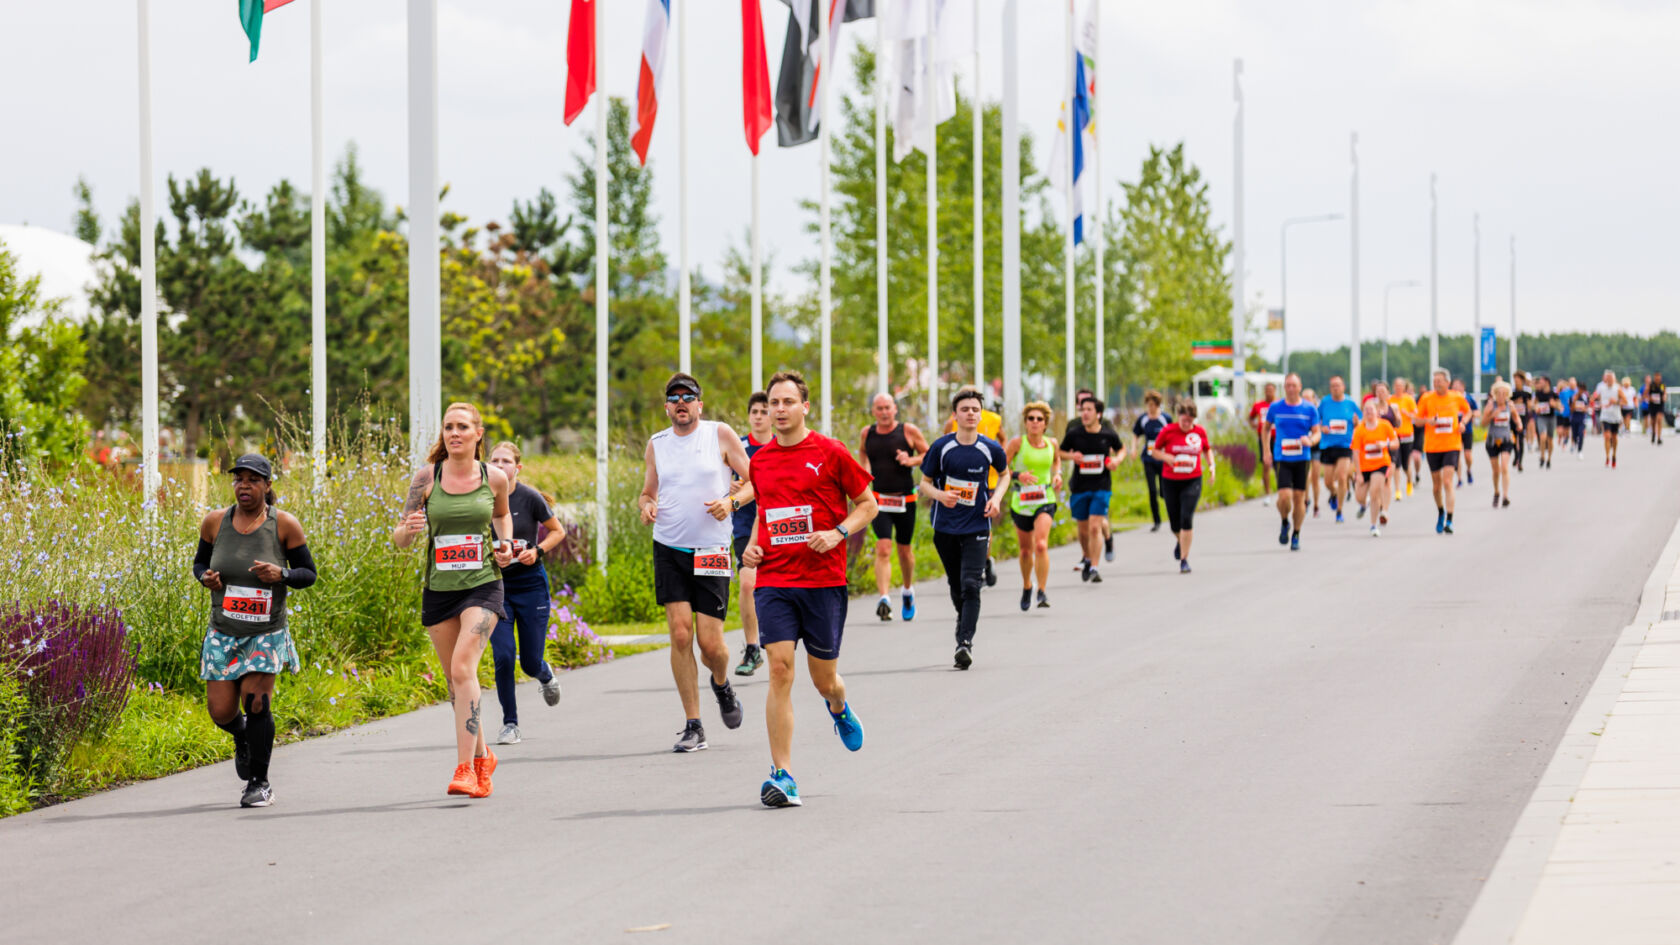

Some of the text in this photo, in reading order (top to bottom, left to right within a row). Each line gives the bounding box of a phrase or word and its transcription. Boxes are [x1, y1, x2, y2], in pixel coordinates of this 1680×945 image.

[771, 520, 808, 535] 3059
[775, 535, 805, 543] SZYMON
[441, 549, 476, 560] 3240
[230, 599, 264, 613] 3241
[230, 612, 262, 621] COLETTE
